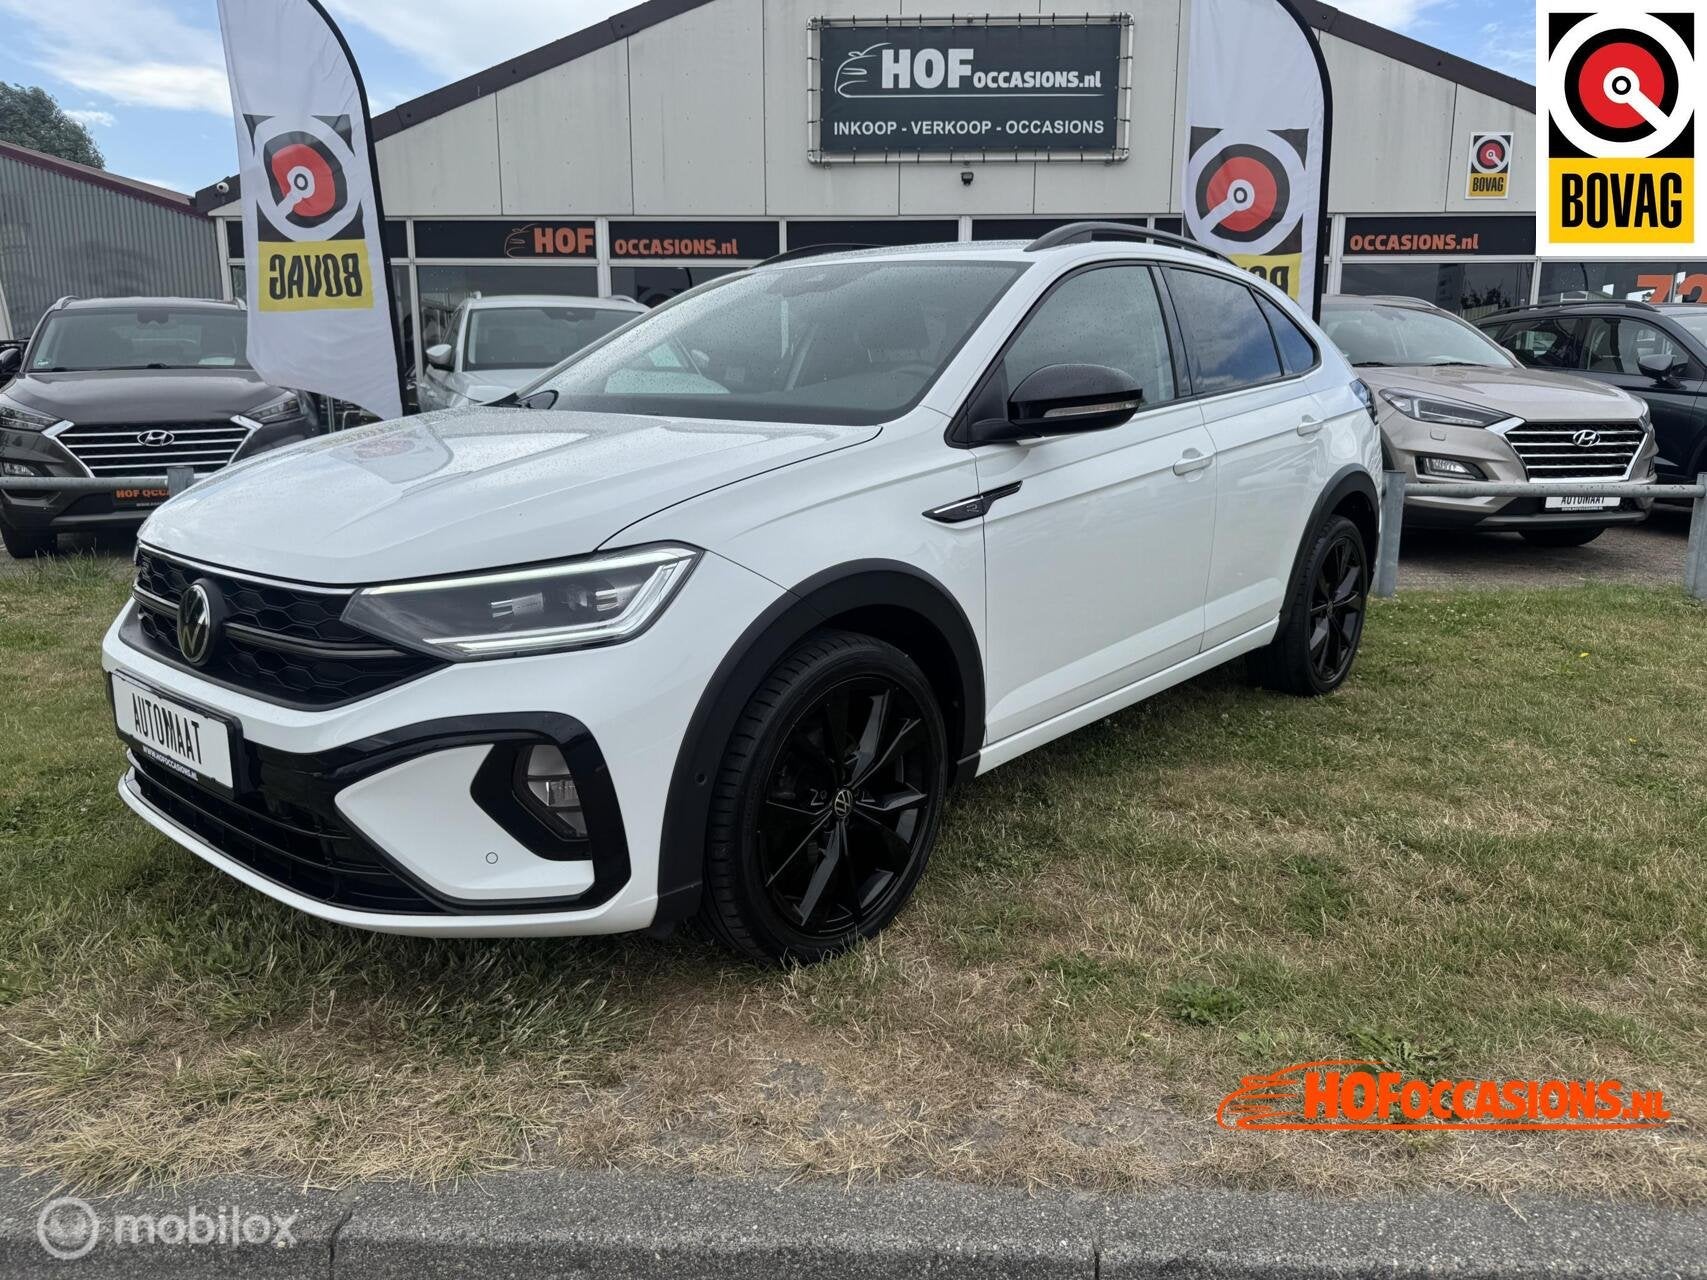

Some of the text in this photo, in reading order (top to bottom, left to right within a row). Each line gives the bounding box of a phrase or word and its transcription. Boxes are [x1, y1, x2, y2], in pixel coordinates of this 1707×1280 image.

[834, 121, 897, 135] INKOOP
[911, 121, 992, 135] VERKOOP
[1005, 120, 1104, 134] OCCASIONS
[1472, 176, 1504, 192] BOVAG
[533, 228, 738, 255] HOF OCCASIONS.nl
[1350, 234, 1479, 251] OCCASIONS.nl
[116, 489, 140, 498] HOF
[131, 692, 202, 765] AUTOMAAT
